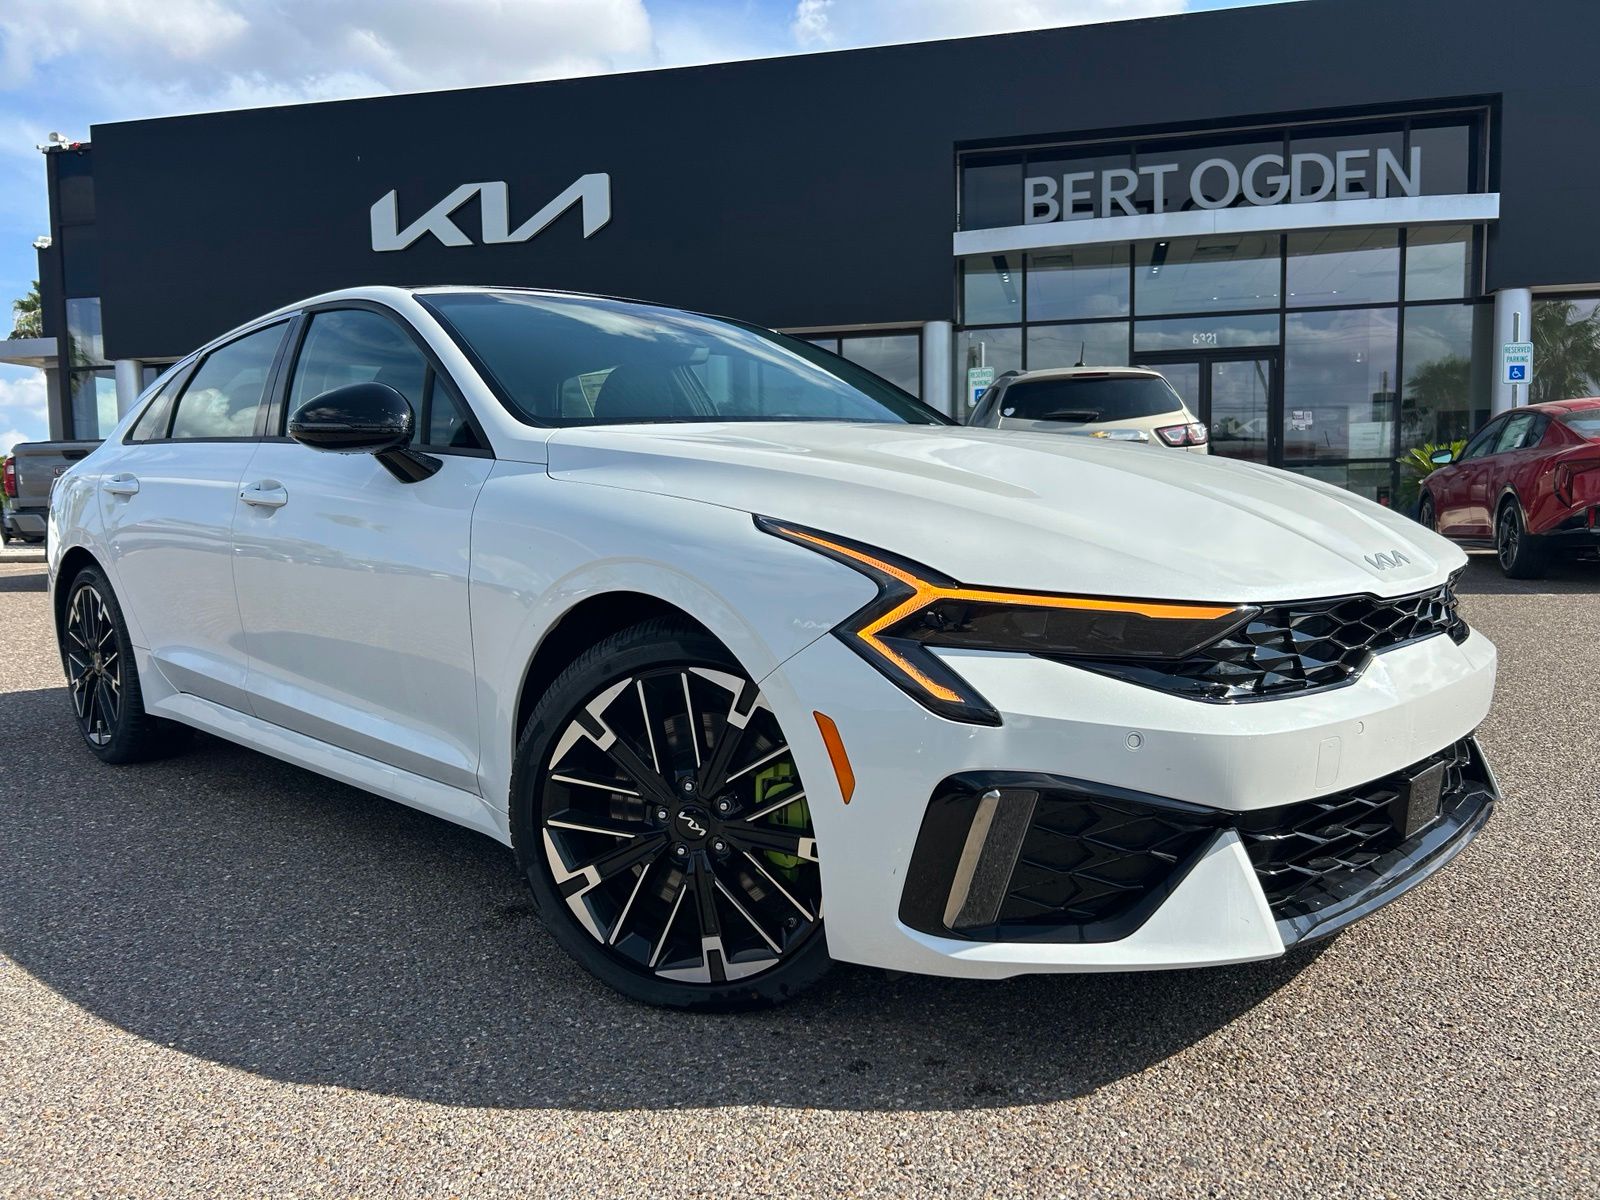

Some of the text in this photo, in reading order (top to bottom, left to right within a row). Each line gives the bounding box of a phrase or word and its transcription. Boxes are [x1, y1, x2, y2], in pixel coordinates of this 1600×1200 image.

[370, 172, 612, 252] KIA
[1024, 146, 1421, 225] BERT OGDEN
[1364, 550, 1410, 570] KIA
